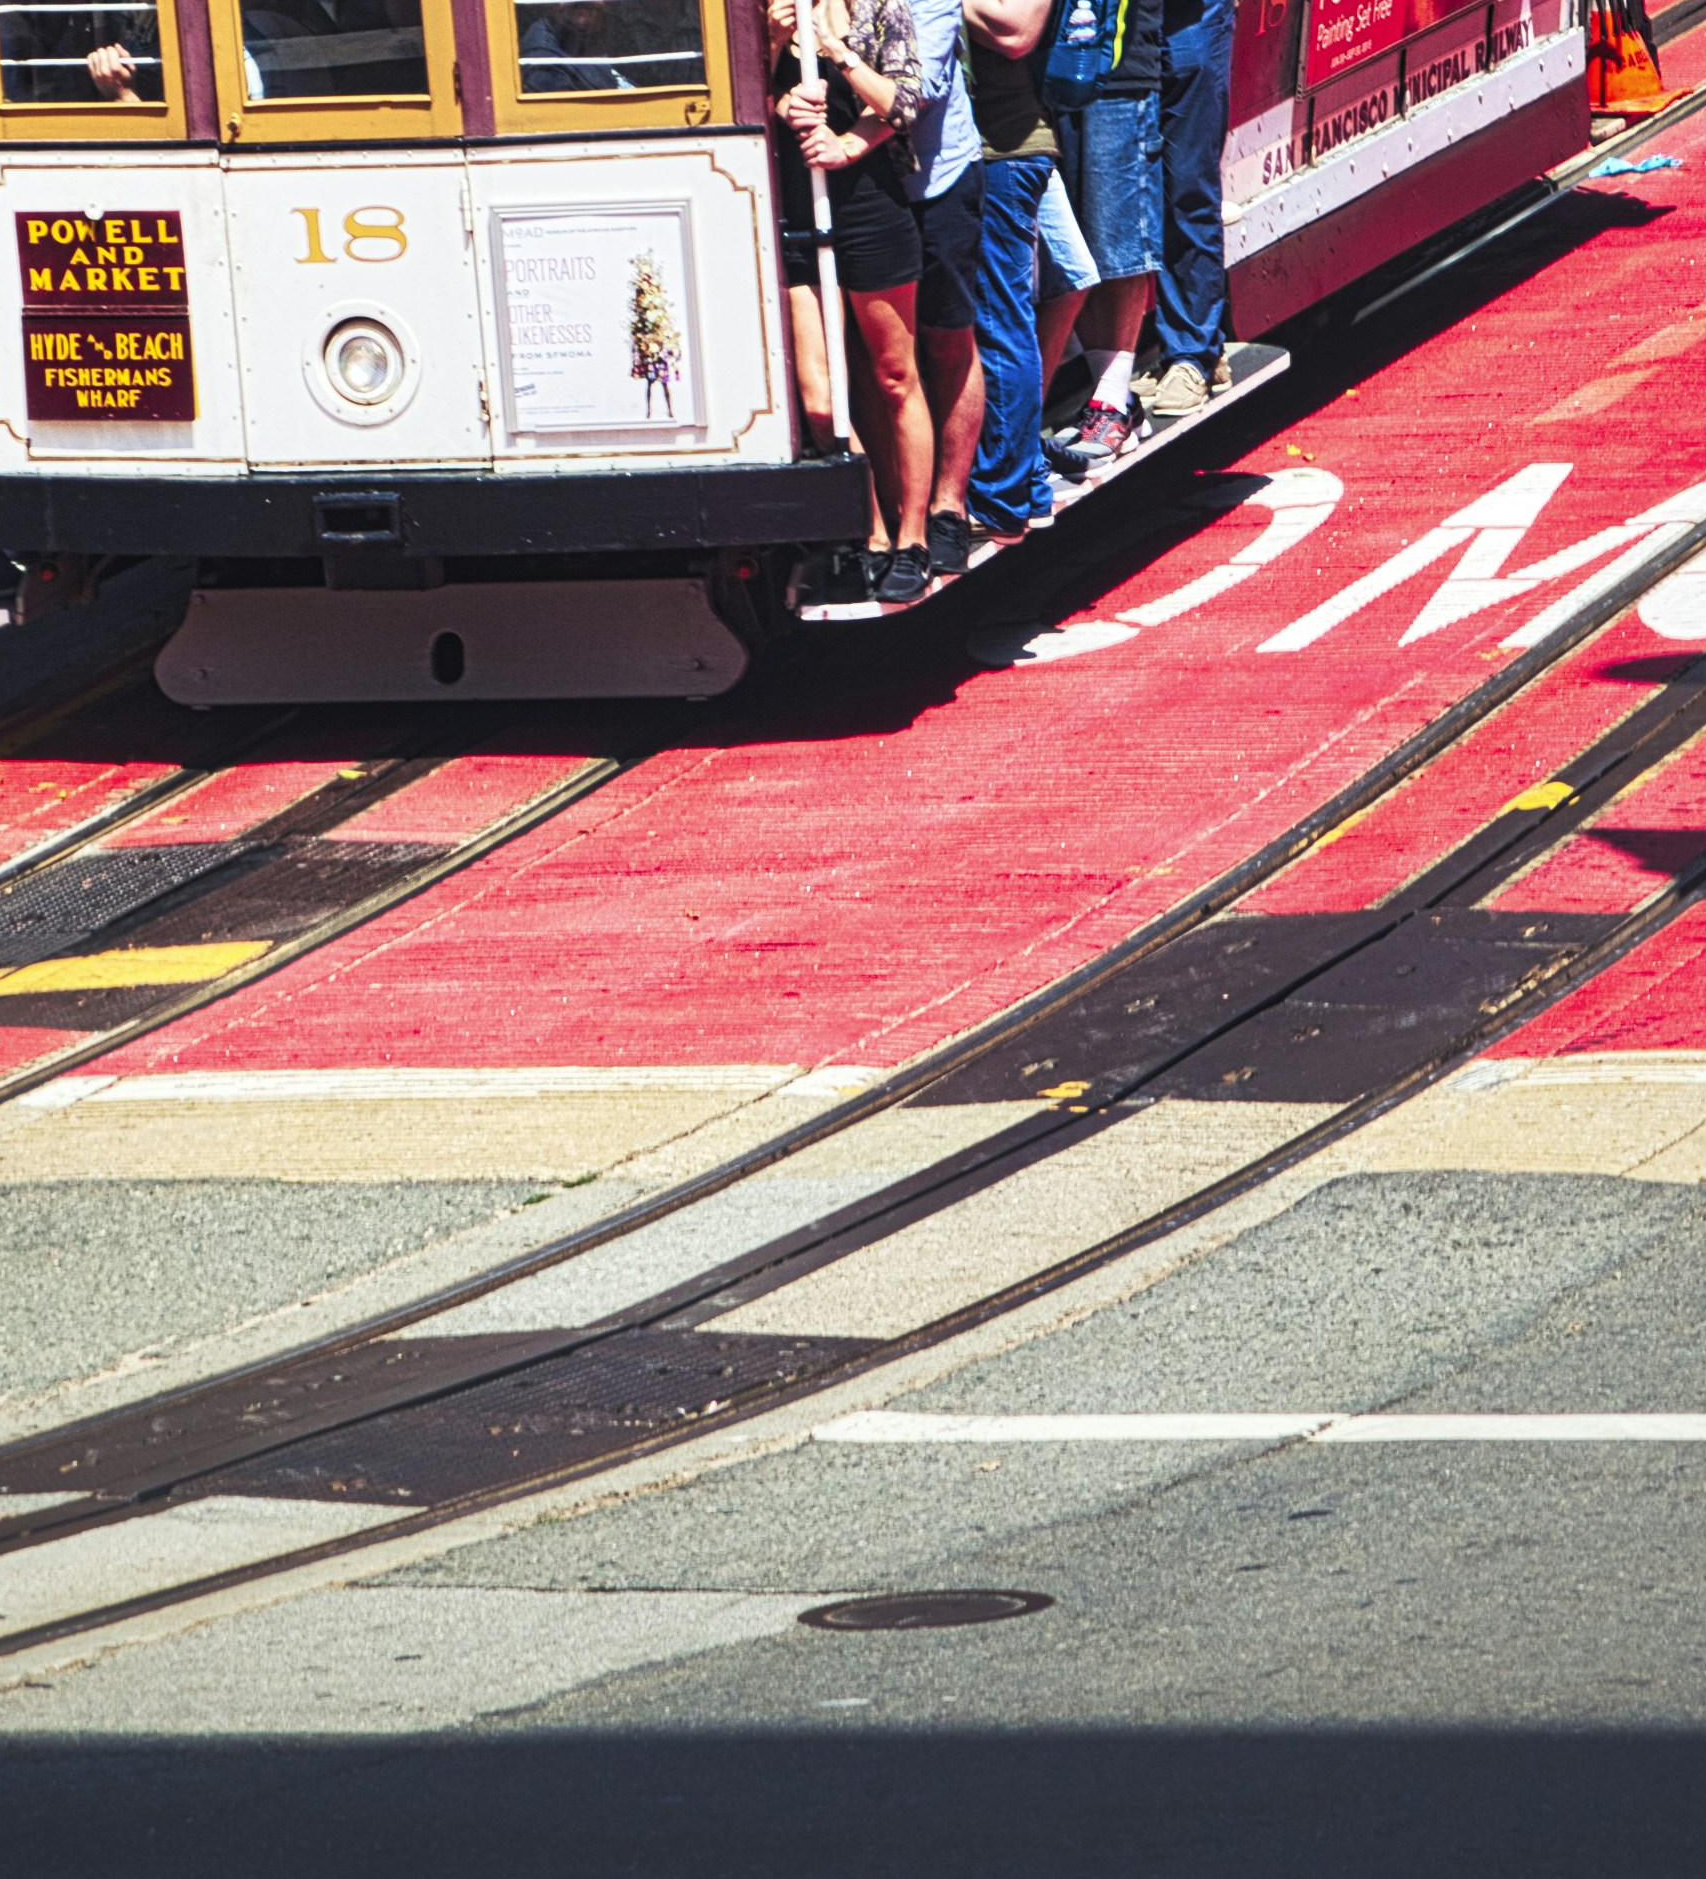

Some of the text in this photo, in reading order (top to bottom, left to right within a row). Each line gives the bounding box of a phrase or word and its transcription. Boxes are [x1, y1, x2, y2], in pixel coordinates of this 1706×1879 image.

[1316, 14, 1355, 51] Painting
[1355, 1, 1372, 32] Set
[1262, 138, 1296, 186] SAN
[26, 219, 179, 244] POWELL
[289, 204, 408, 264] 18
[69, 246, 145, 265] AND
[29, 267, 185, 291] MARKET
[504, 256, 597, 283] PORTRAITS
[507, 288, 530, 297] AND
[509, 303, 553, 325] OTHER
[29, 332, 184, 360] HYDE AND BEACH
[510, 324, 593, 346] LIKENESSES
[546, 351, 593, 360] SFMOMA
[44, 367, 173, 387] FISHERMANS
[76, 389, 143, 408] WHARF
